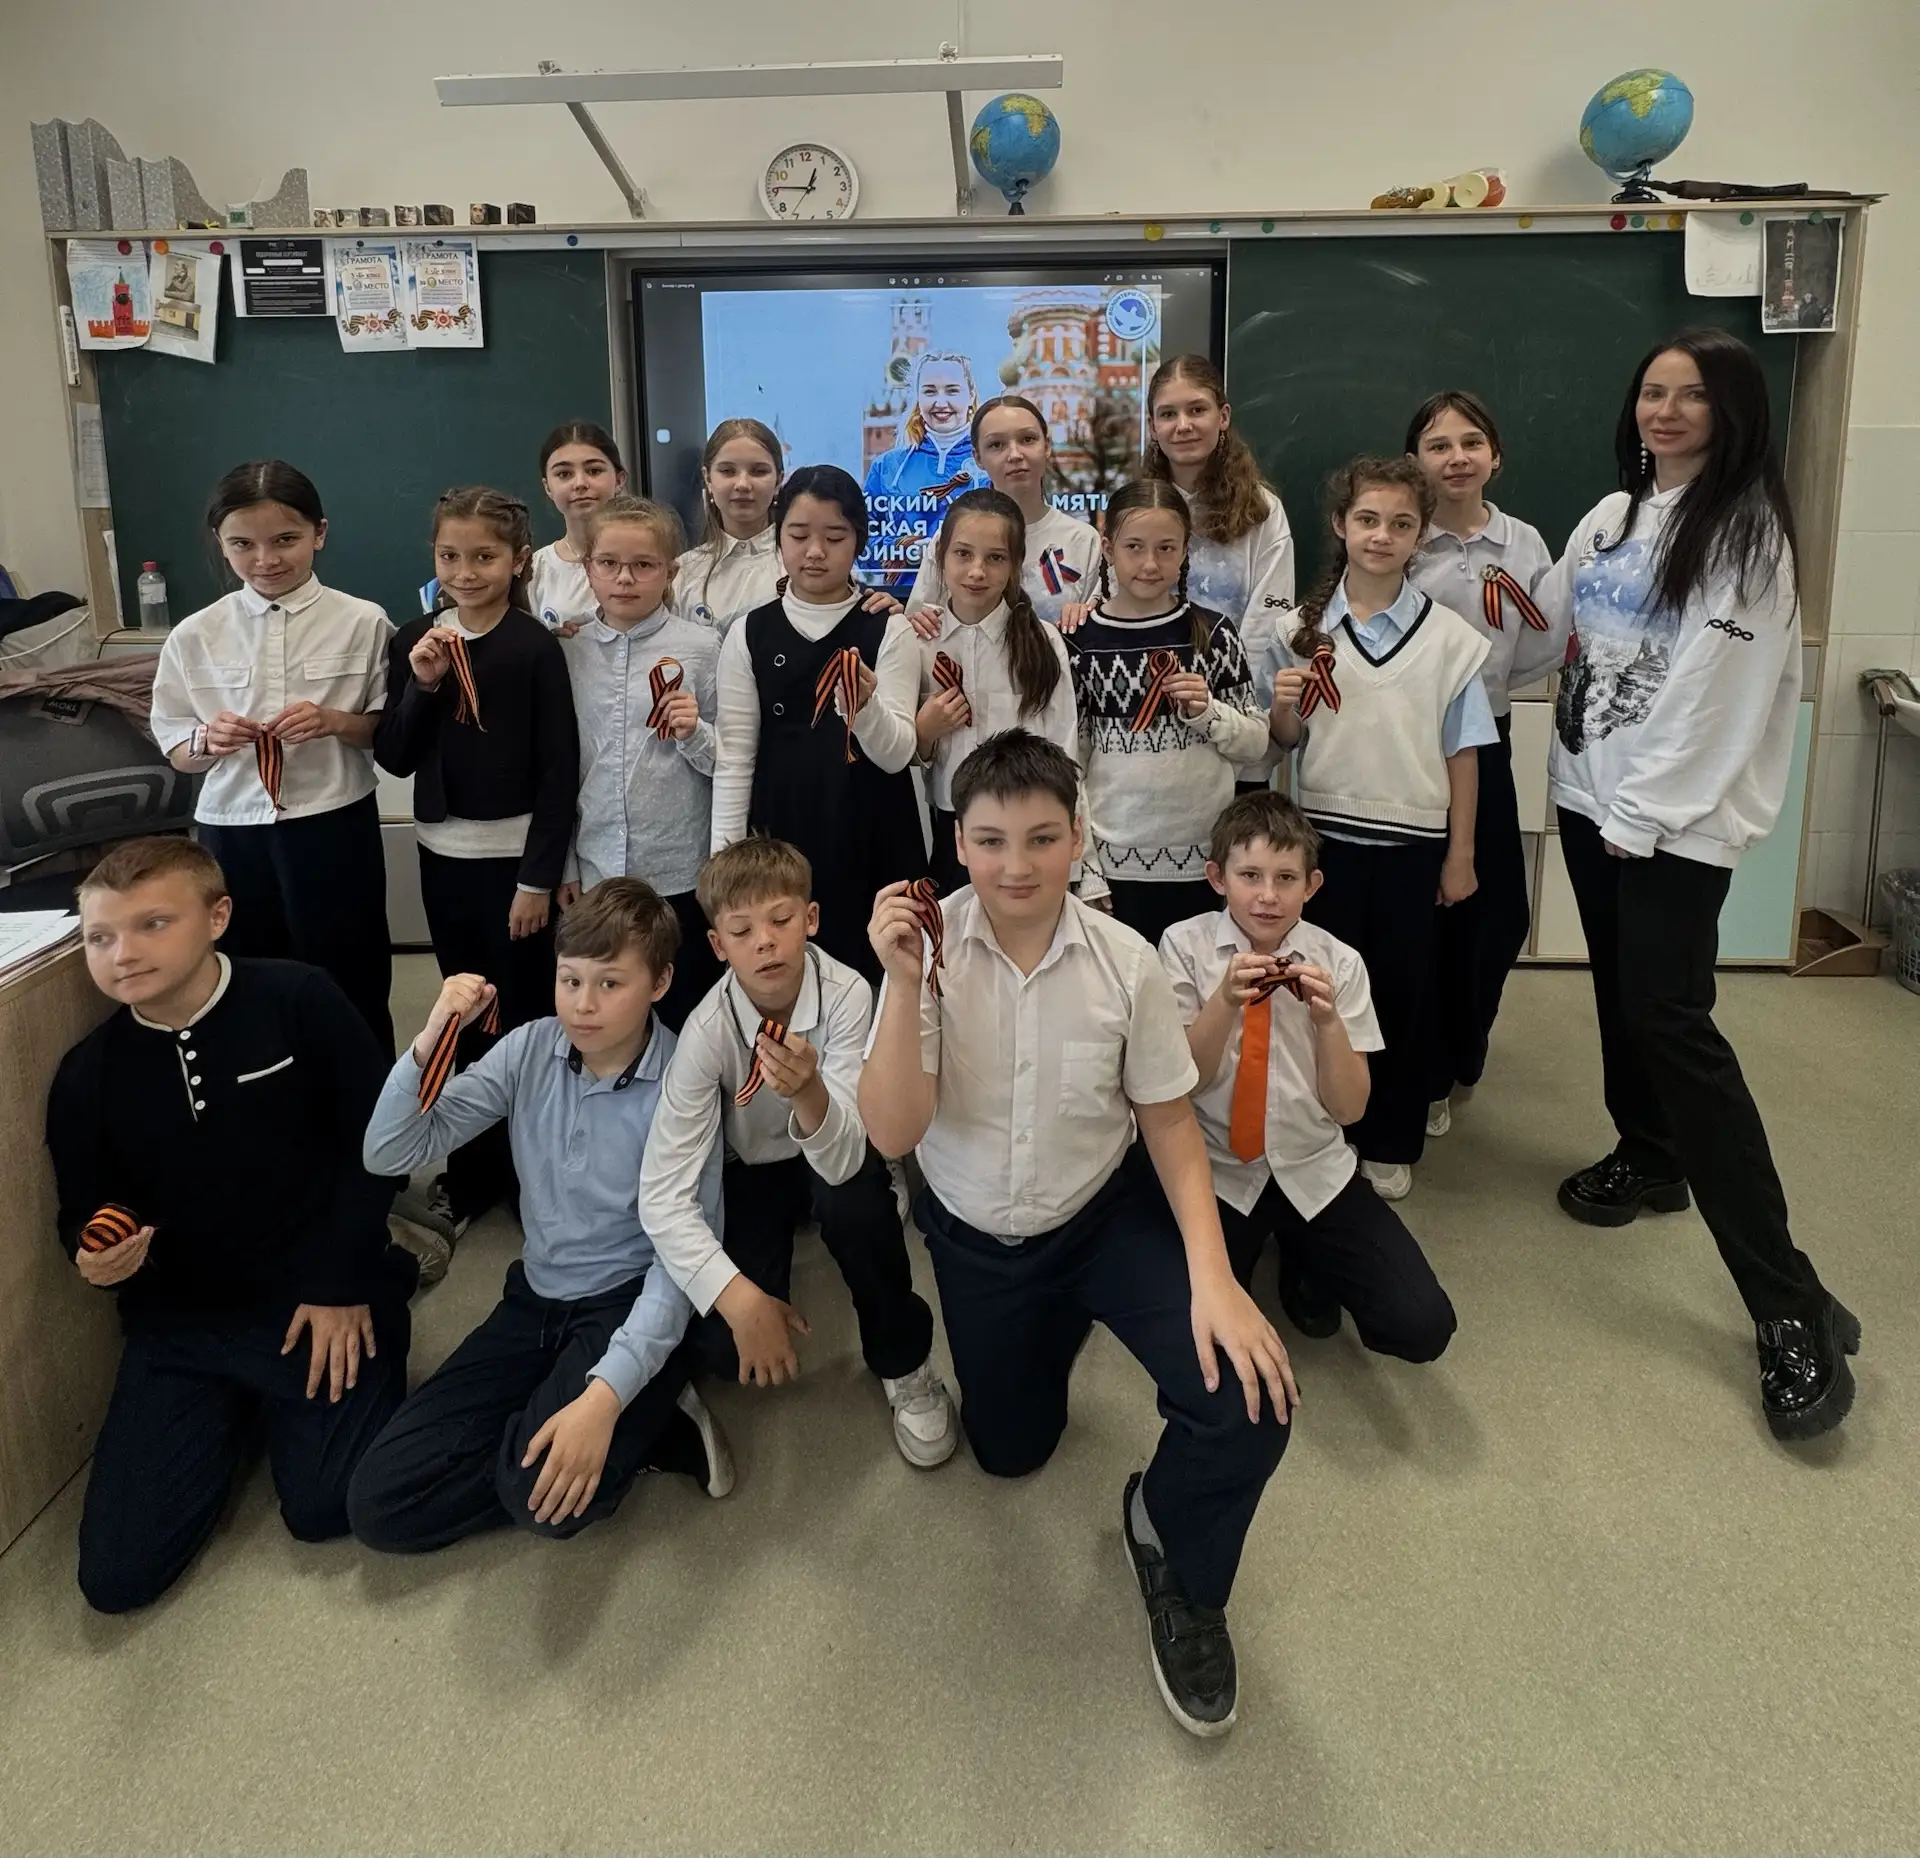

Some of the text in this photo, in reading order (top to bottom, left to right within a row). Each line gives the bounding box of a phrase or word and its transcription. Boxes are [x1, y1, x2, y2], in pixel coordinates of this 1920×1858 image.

[799, 152, 812, 162] 12
[820, 156, 826, 165] 1
[784, 158, 794, 168] 11
[775, 170, 788, 181] 10
[834, 166, 841, 176] 2
[840, 181, 847, 192] 3
[772, 187, 779, 197] 9
[779, 202, 787, 212] 8
[836, 198, 844, 208] 4
[826, 210, 833, 219] 5
[346, 256, 383, 265] ГРАМОТА
[422, 252, 459, 260] ГРАМОТА
[363, 282, 390, 290] МЕСТО
[438, 278, 464, 286] МЕСТО
[864, 490, 938, 512] ЙСКИЙ
[1051, 493, 1109, 511] МЯТИ
[867, 519, 928, 537] СКАЯ
[860, 544, 927, 561] ОИНС
